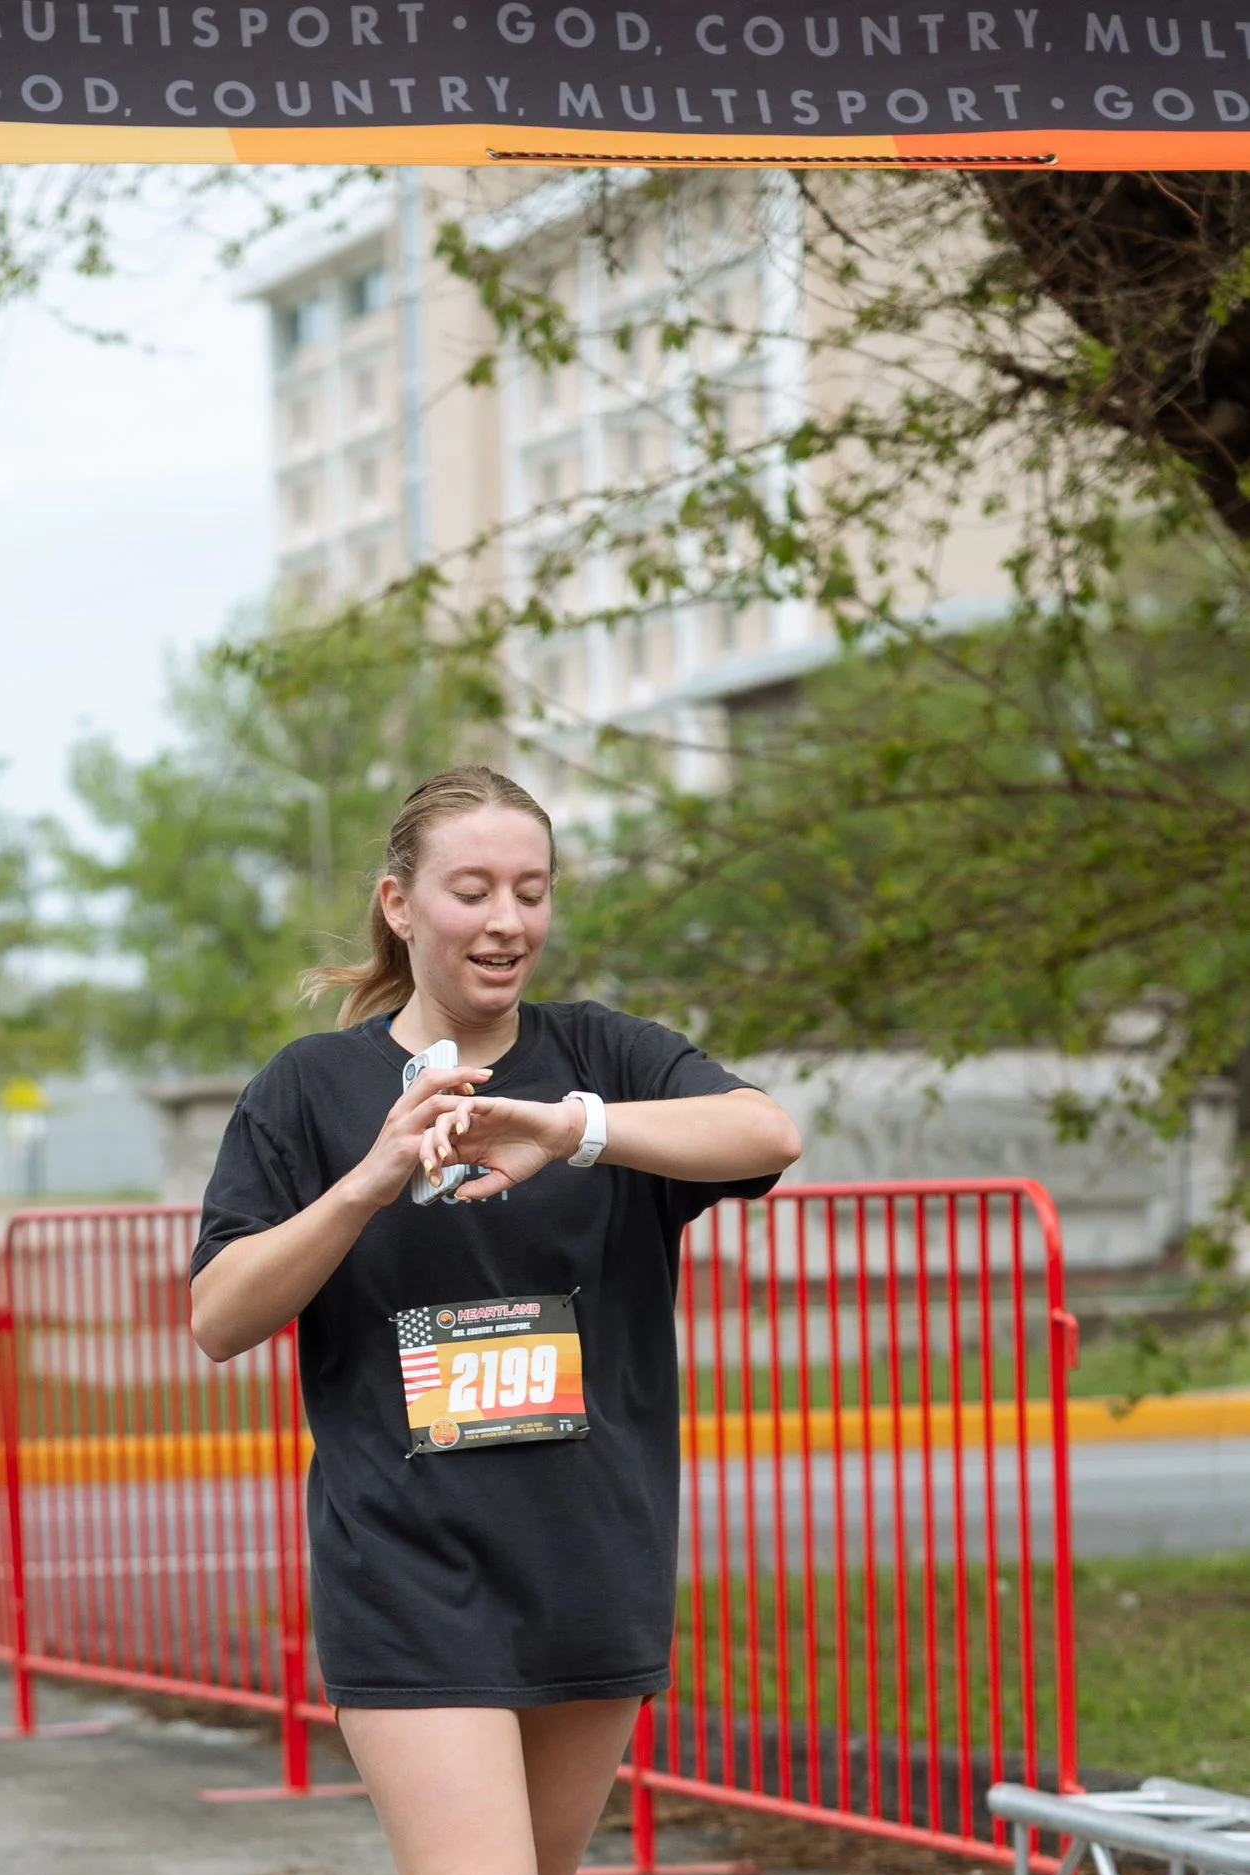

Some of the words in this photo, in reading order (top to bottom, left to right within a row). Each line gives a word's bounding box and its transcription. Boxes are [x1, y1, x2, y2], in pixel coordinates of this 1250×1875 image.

[496, 3, 663, 55] GOD,
[695, 10, 1054, 57] COUNTRY,
[164, 76, 526, 118] COUNTRY,
[558, 80, 1022, 125] MULTISPORT
[457, 1302, 541, 1322] HEARTLAND
[448, 1345, 558, 1413] 2199
